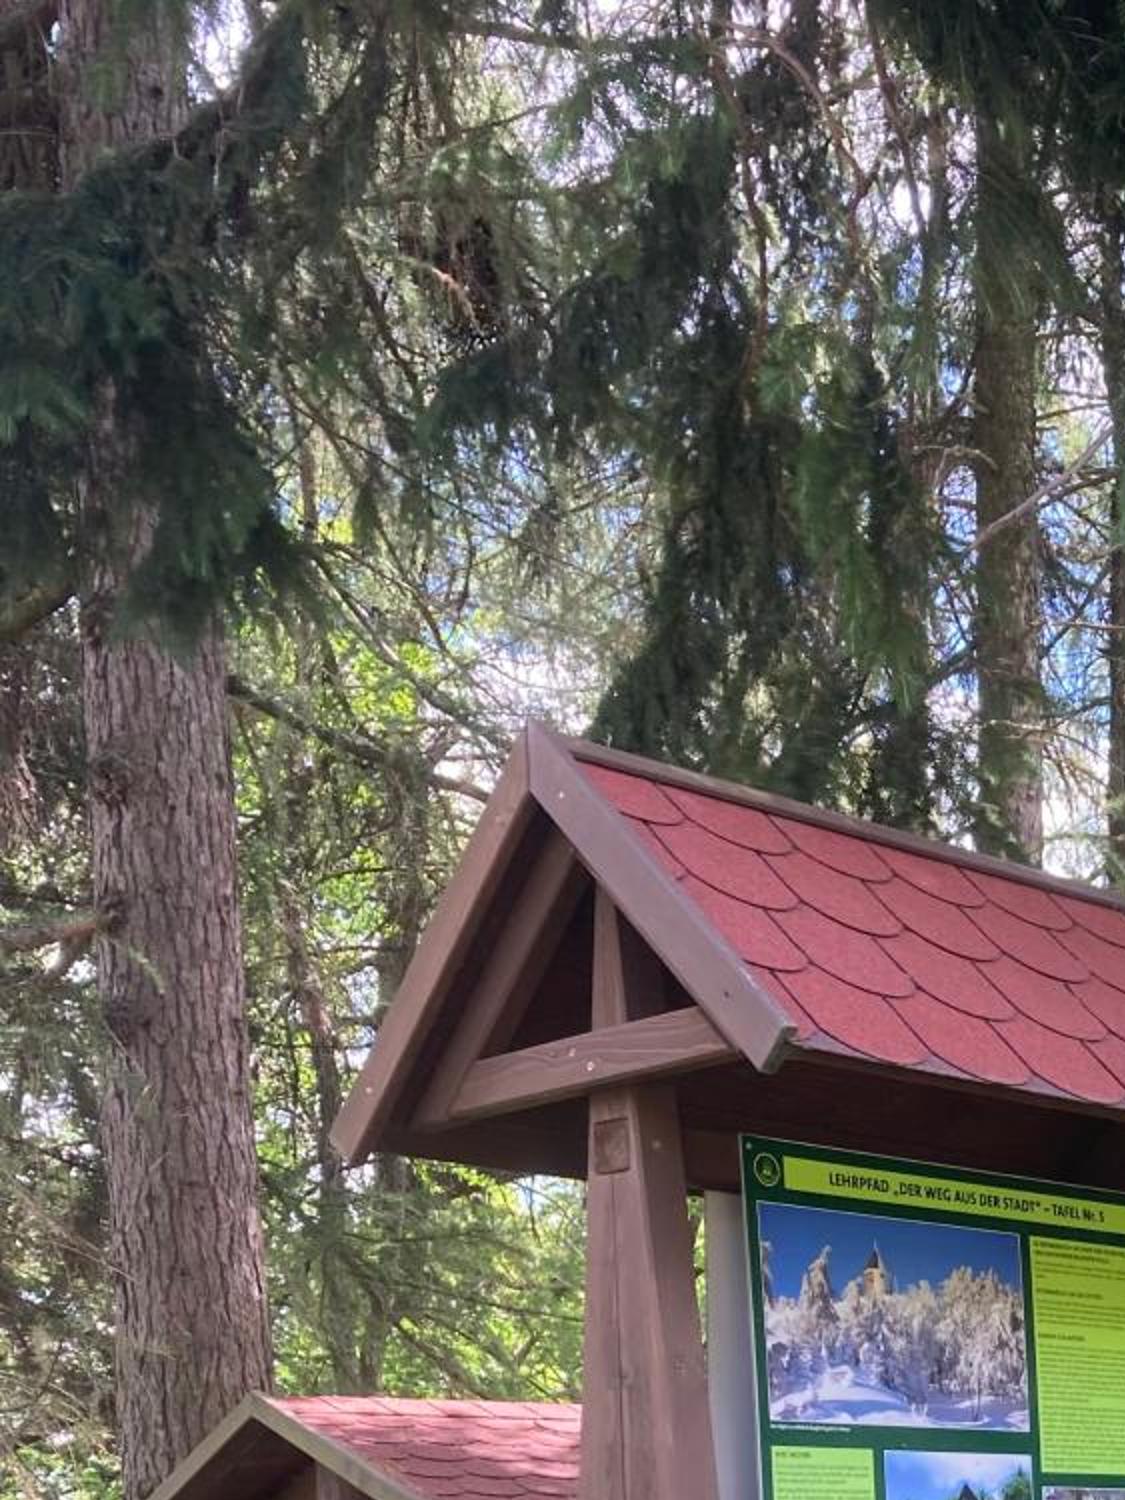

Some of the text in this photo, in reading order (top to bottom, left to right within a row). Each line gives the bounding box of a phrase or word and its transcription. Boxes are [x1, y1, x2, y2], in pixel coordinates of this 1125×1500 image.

[829, 1172, 889, 1193] LEHRPFAD
[923, 1185, 951, 1201] WEG
[955, 1190, 977, 1205] AUS
[979, 1193, 1001, 1208] DER
[1053, 1203, 1081, 1219] TAFEL
